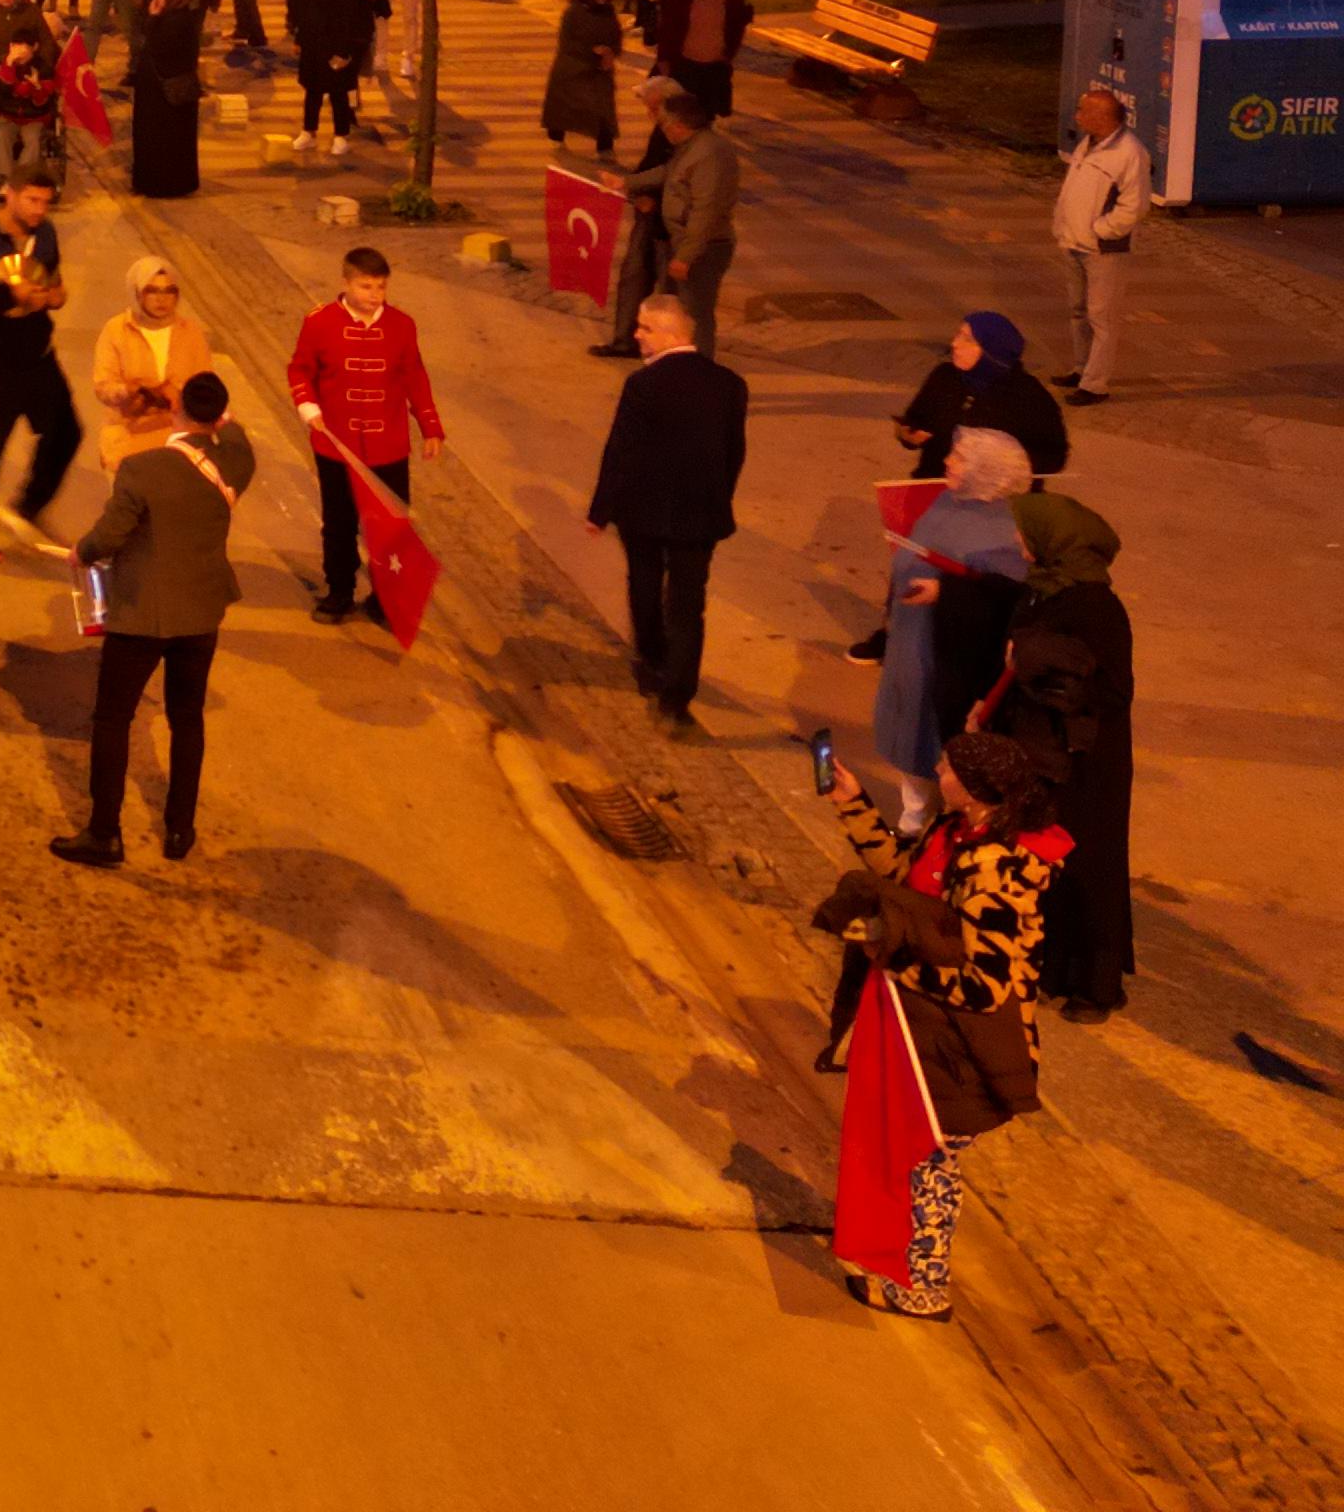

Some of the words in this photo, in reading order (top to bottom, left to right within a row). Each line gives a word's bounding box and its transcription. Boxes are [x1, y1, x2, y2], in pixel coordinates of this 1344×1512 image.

[1287, 19, 1340, 31] KARTON
[1280, 96, 1340, 116] SIFIR
[1280, 115, 1338, 136] ATIK
